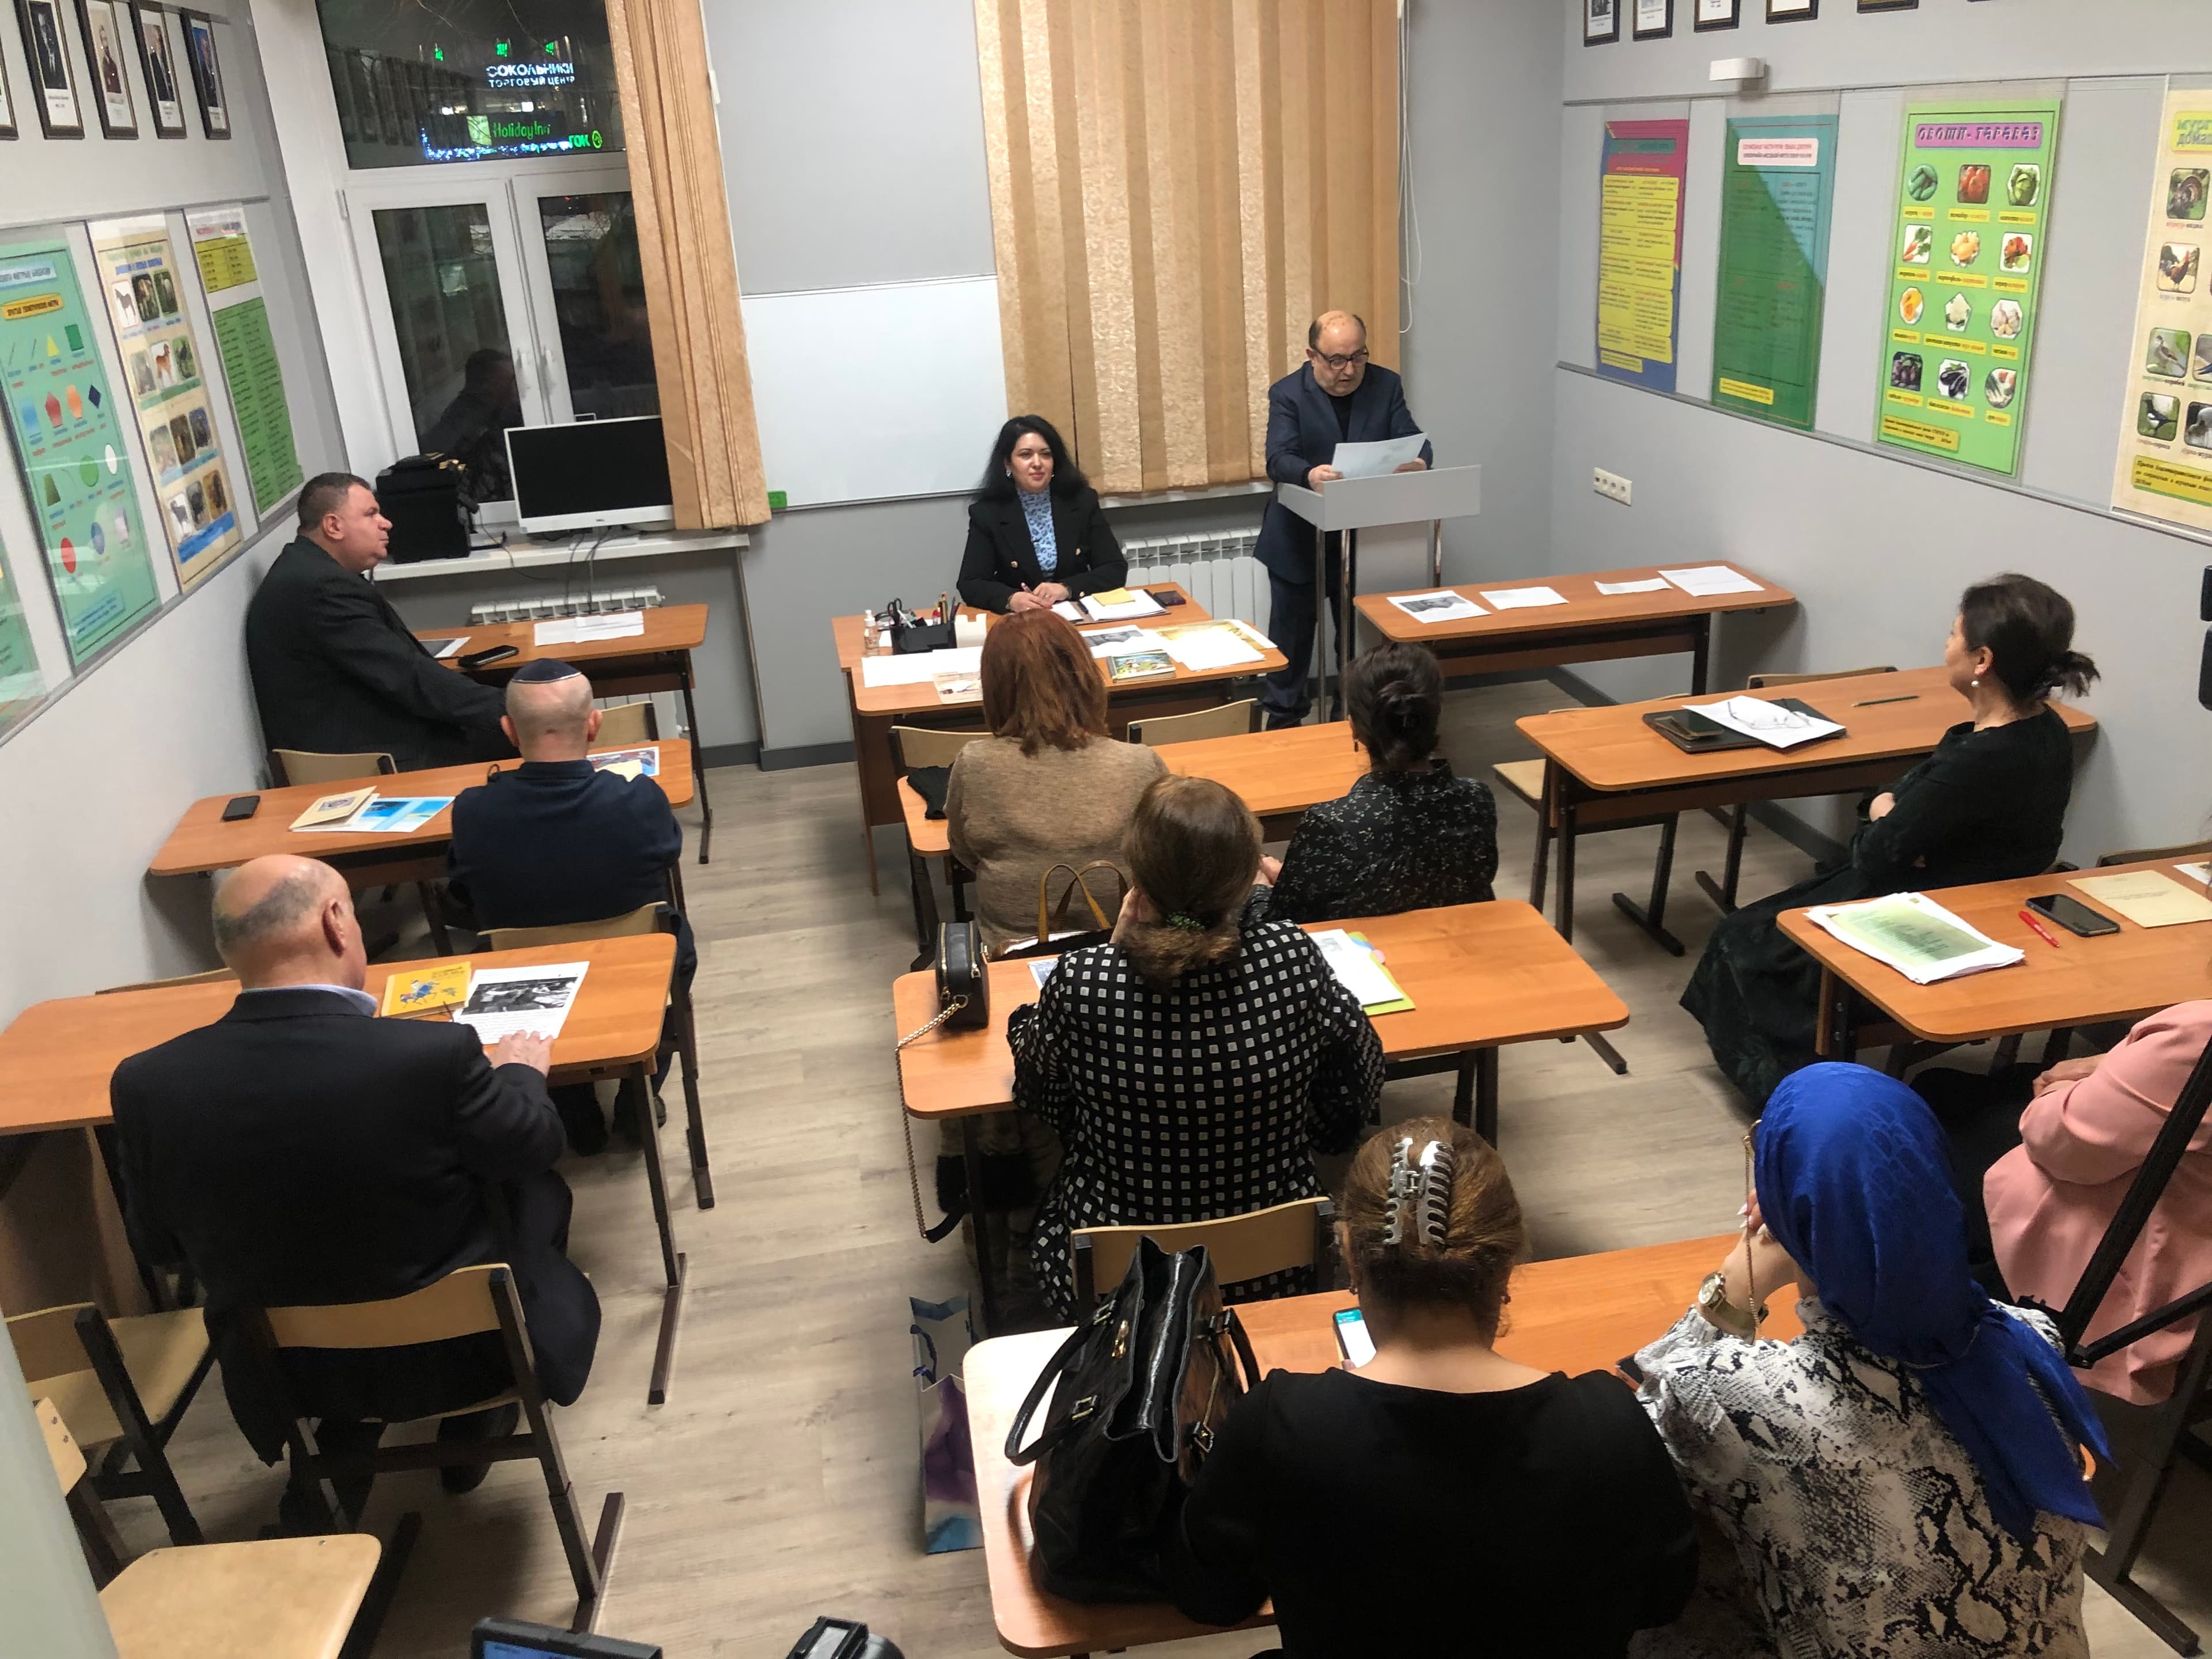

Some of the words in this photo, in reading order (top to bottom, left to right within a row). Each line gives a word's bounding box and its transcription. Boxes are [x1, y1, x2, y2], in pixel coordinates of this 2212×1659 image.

[486, 63, 574, 77] СОКОЛЬНИКИ
[488, 76, 546, 88] ТОРГОВЫЙ
[548, 75, 575, 86] ЦЕНТР
[493, 120, 533, 140] Holiday
